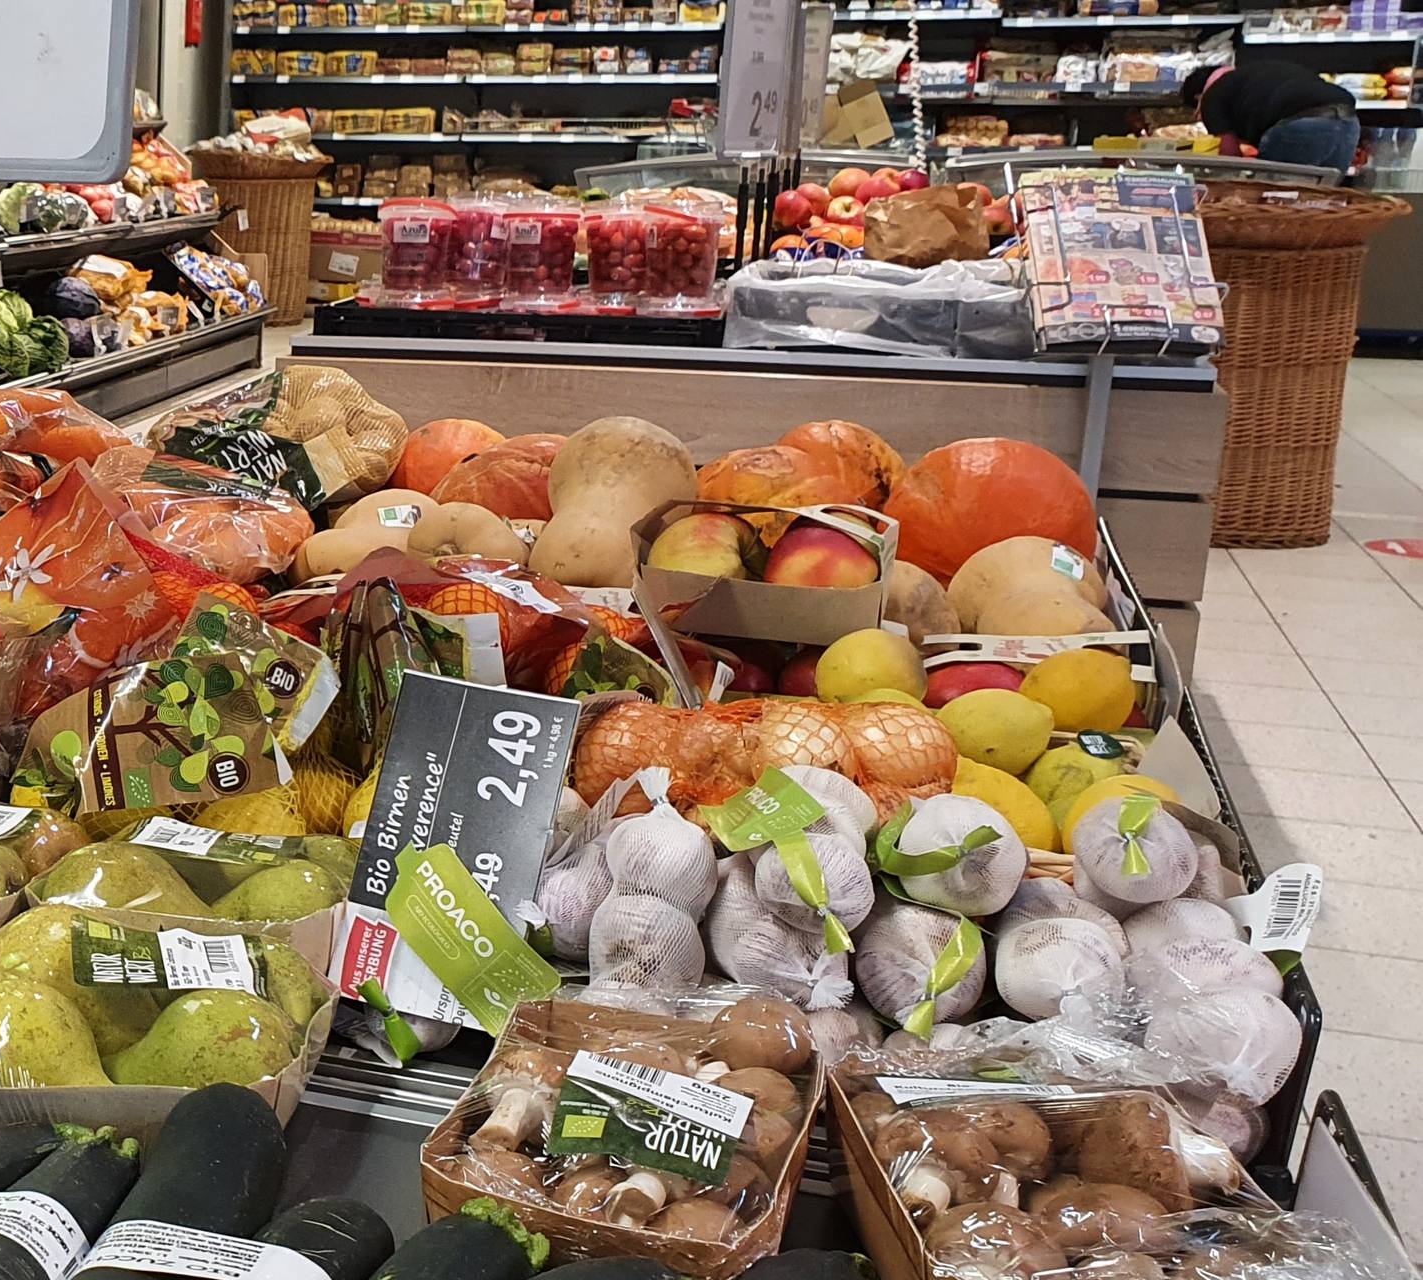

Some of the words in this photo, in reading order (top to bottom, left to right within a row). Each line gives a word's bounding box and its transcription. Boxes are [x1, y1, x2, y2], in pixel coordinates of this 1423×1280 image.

[239, 450, 288, 482] NAT
[269, 667, 295, 692] BIO
[215, 760, 240, 788] BIO
[477, 709, 541, 808] 2,49
[100, 771, 116, 806] LIMONES
[413, 751, 444, 853] verence"
[378, 774, 413, 853] Birnen
[449, 812, 465, 851] eutel
[365, 858, 392, 896] Bio
[416, 860, 495, 958] PROACO
[354, 925, 373, 966] unserer
[348, 969, 364, 992] Aus
[432, 987, 452, 1022] Urspr
[644, 1120, 723, 1171] NATUR
[185, 1264, 240, 1279] BIO
